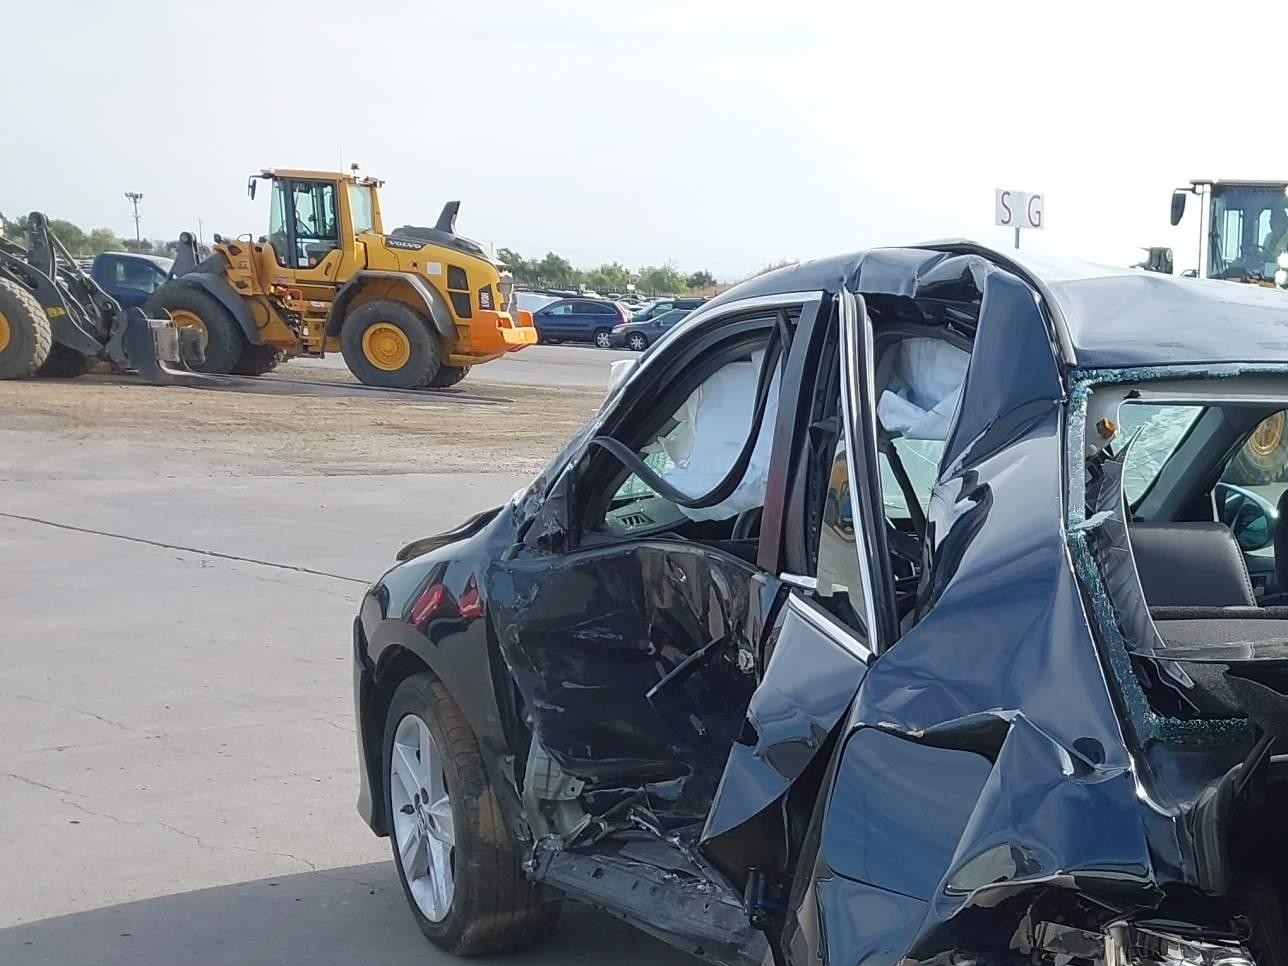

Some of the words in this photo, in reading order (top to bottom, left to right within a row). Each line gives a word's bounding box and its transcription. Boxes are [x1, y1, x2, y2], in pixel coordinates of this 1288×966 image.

[1000, 190, 1012, 225] S
[1027, 194, 1042, 228] G
[388, 240, 422, 249] VOLVO
